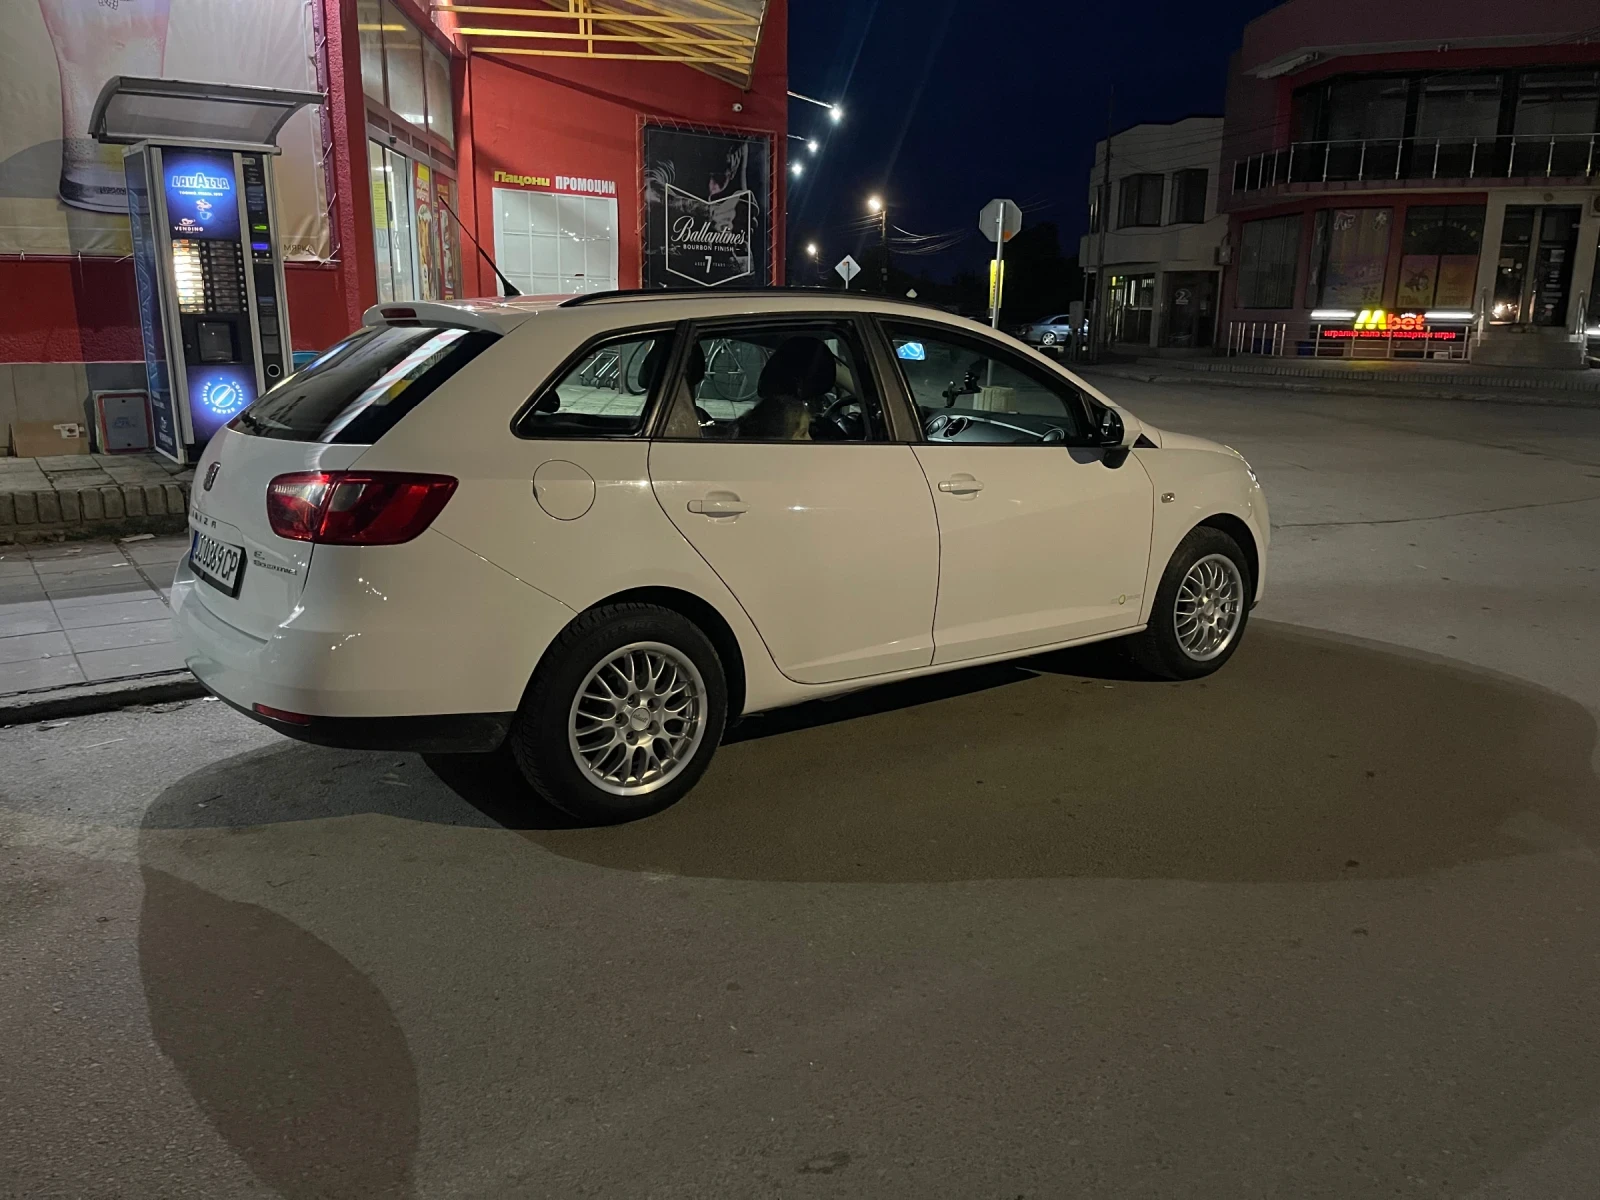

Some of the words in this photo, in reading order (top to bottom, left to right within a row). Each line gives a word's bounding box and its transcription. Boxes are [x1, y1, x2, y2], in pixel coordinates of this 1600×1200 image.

[172, 173, 230, 190] LAVAZZA
[494, 171, 550, 186] Пацони
[555, 176, 616, 195] ПРОМОЦИИ
[671, 215, 746, 245] Ballantine's
[704, 256, 712, 274] 7
[1434, 332, 1456, 340] игри
